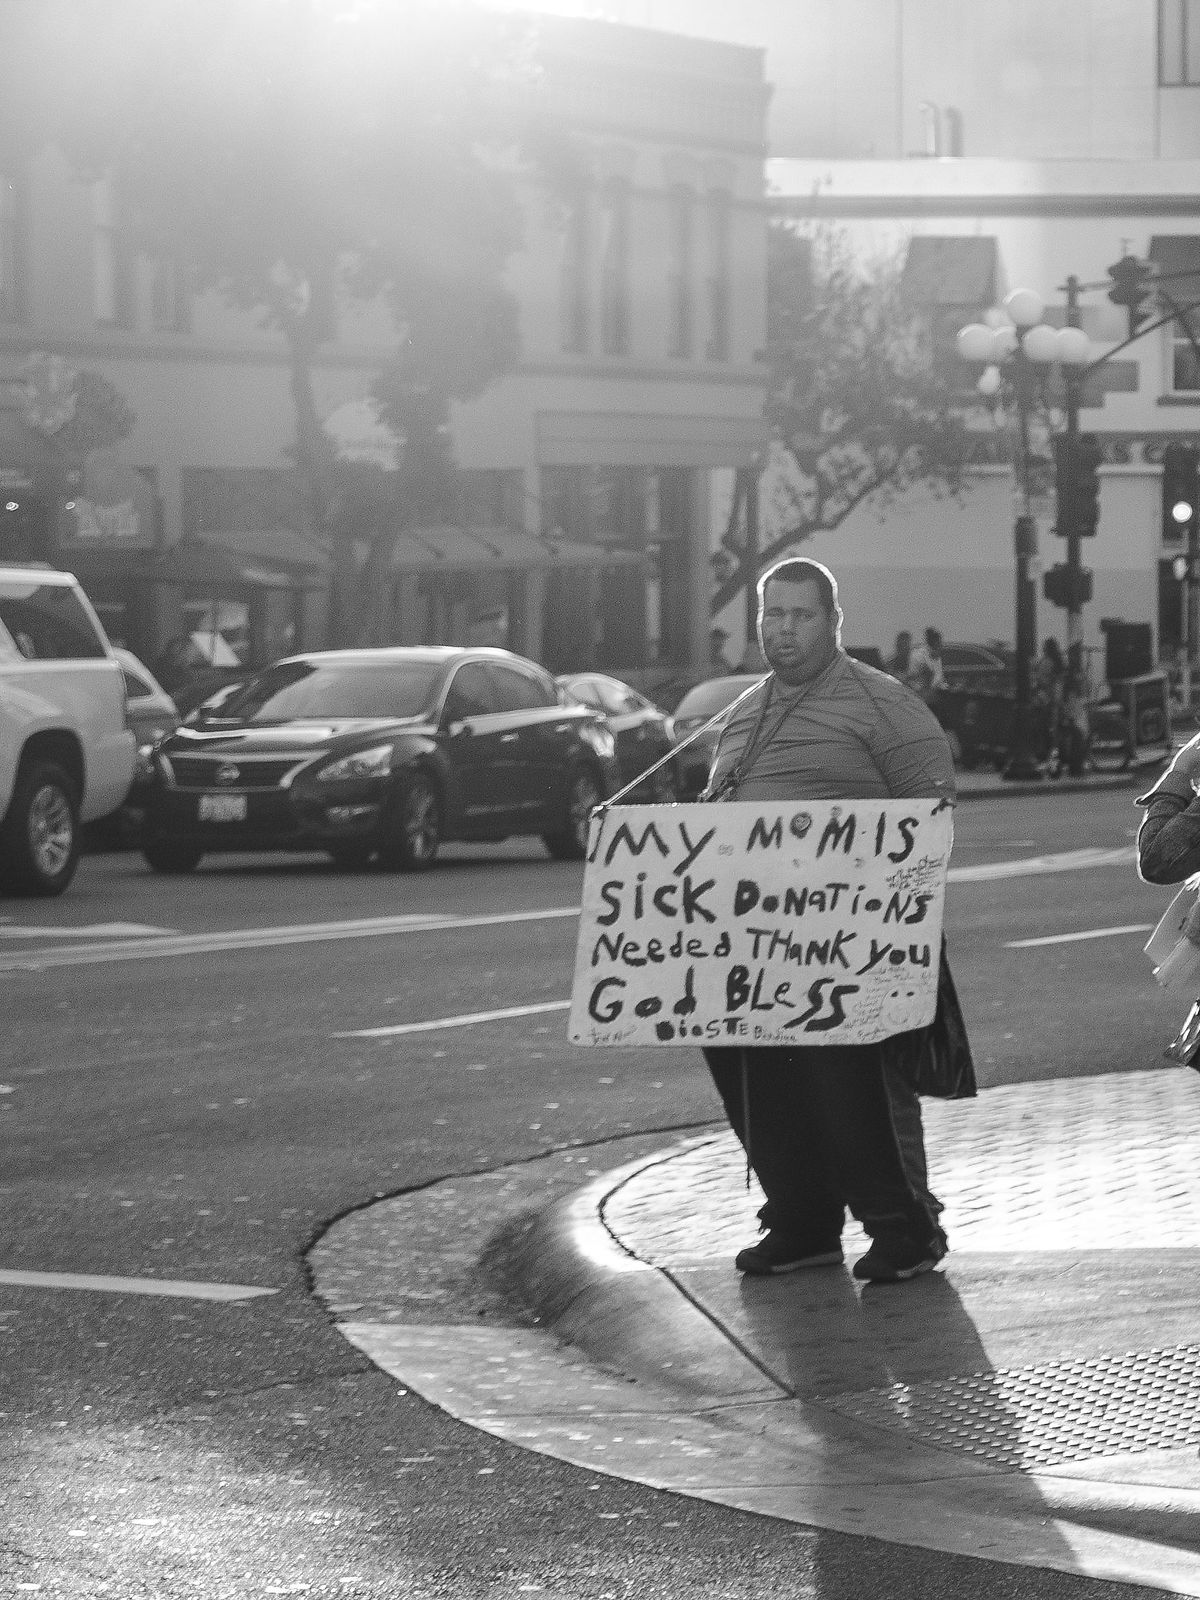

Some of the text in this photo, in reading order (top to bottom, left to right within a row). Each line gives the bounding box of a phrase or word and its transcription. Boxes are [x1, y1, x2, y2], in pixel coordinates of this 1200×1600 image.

[873, 811, 920, 864] IS
[590, 930, 732, 967] Needed
[588, 965, 698, 1024] God
